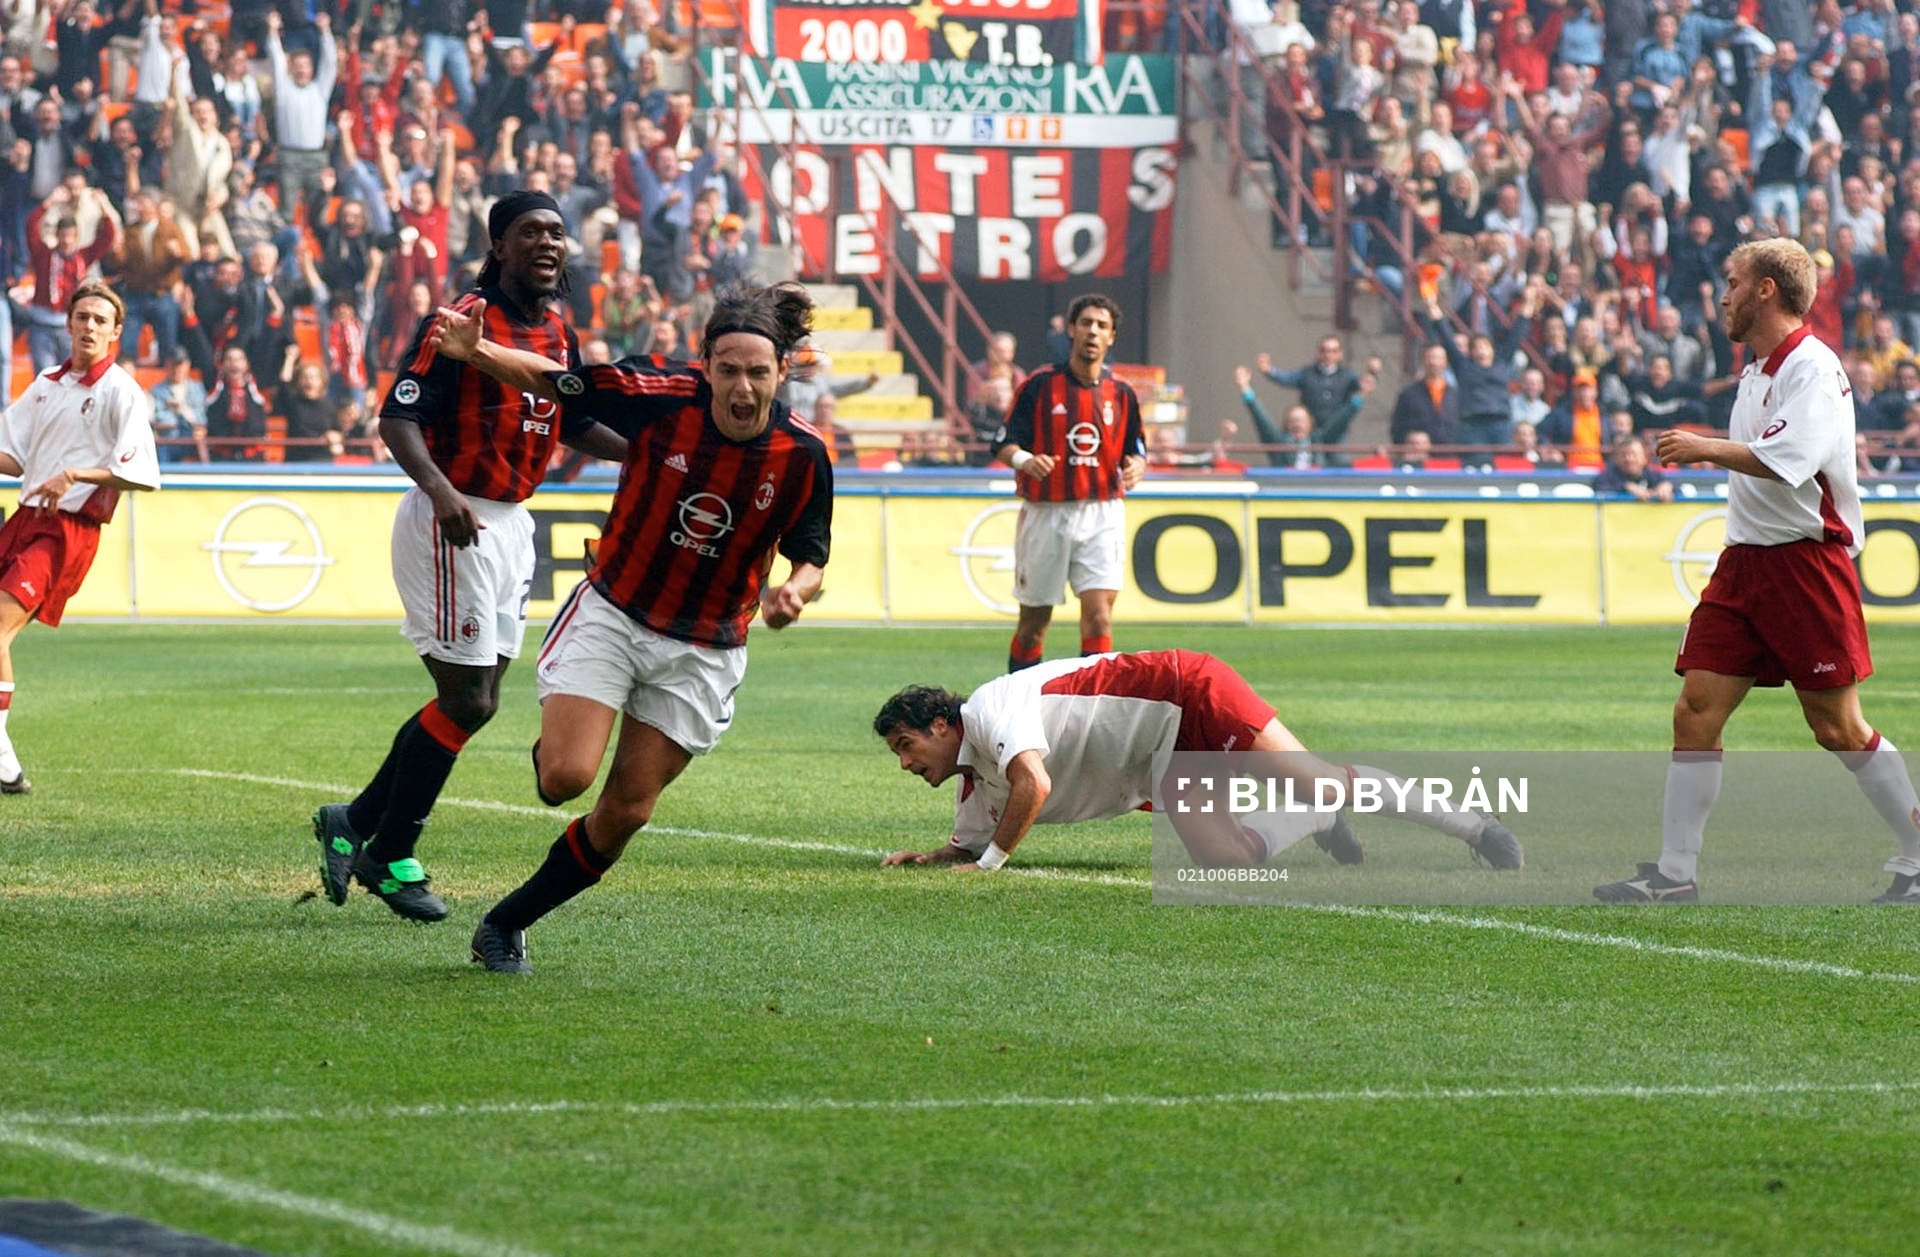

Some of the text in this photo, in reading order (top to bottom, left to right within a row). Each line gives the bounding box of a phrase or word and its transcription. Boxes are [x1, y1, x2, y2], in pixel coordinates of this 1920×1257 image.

[800, 18, 1055, 67] 2000 T.B.
[825, 58, 920, 84] RASINI
[824, 83, 1052, 113] ASSICURAZIONI
[818, 115, 954, 138] USCITA 17
[670, 530, 720, 558] OPEL
[1132, 513, 1542, 608] OPEL
